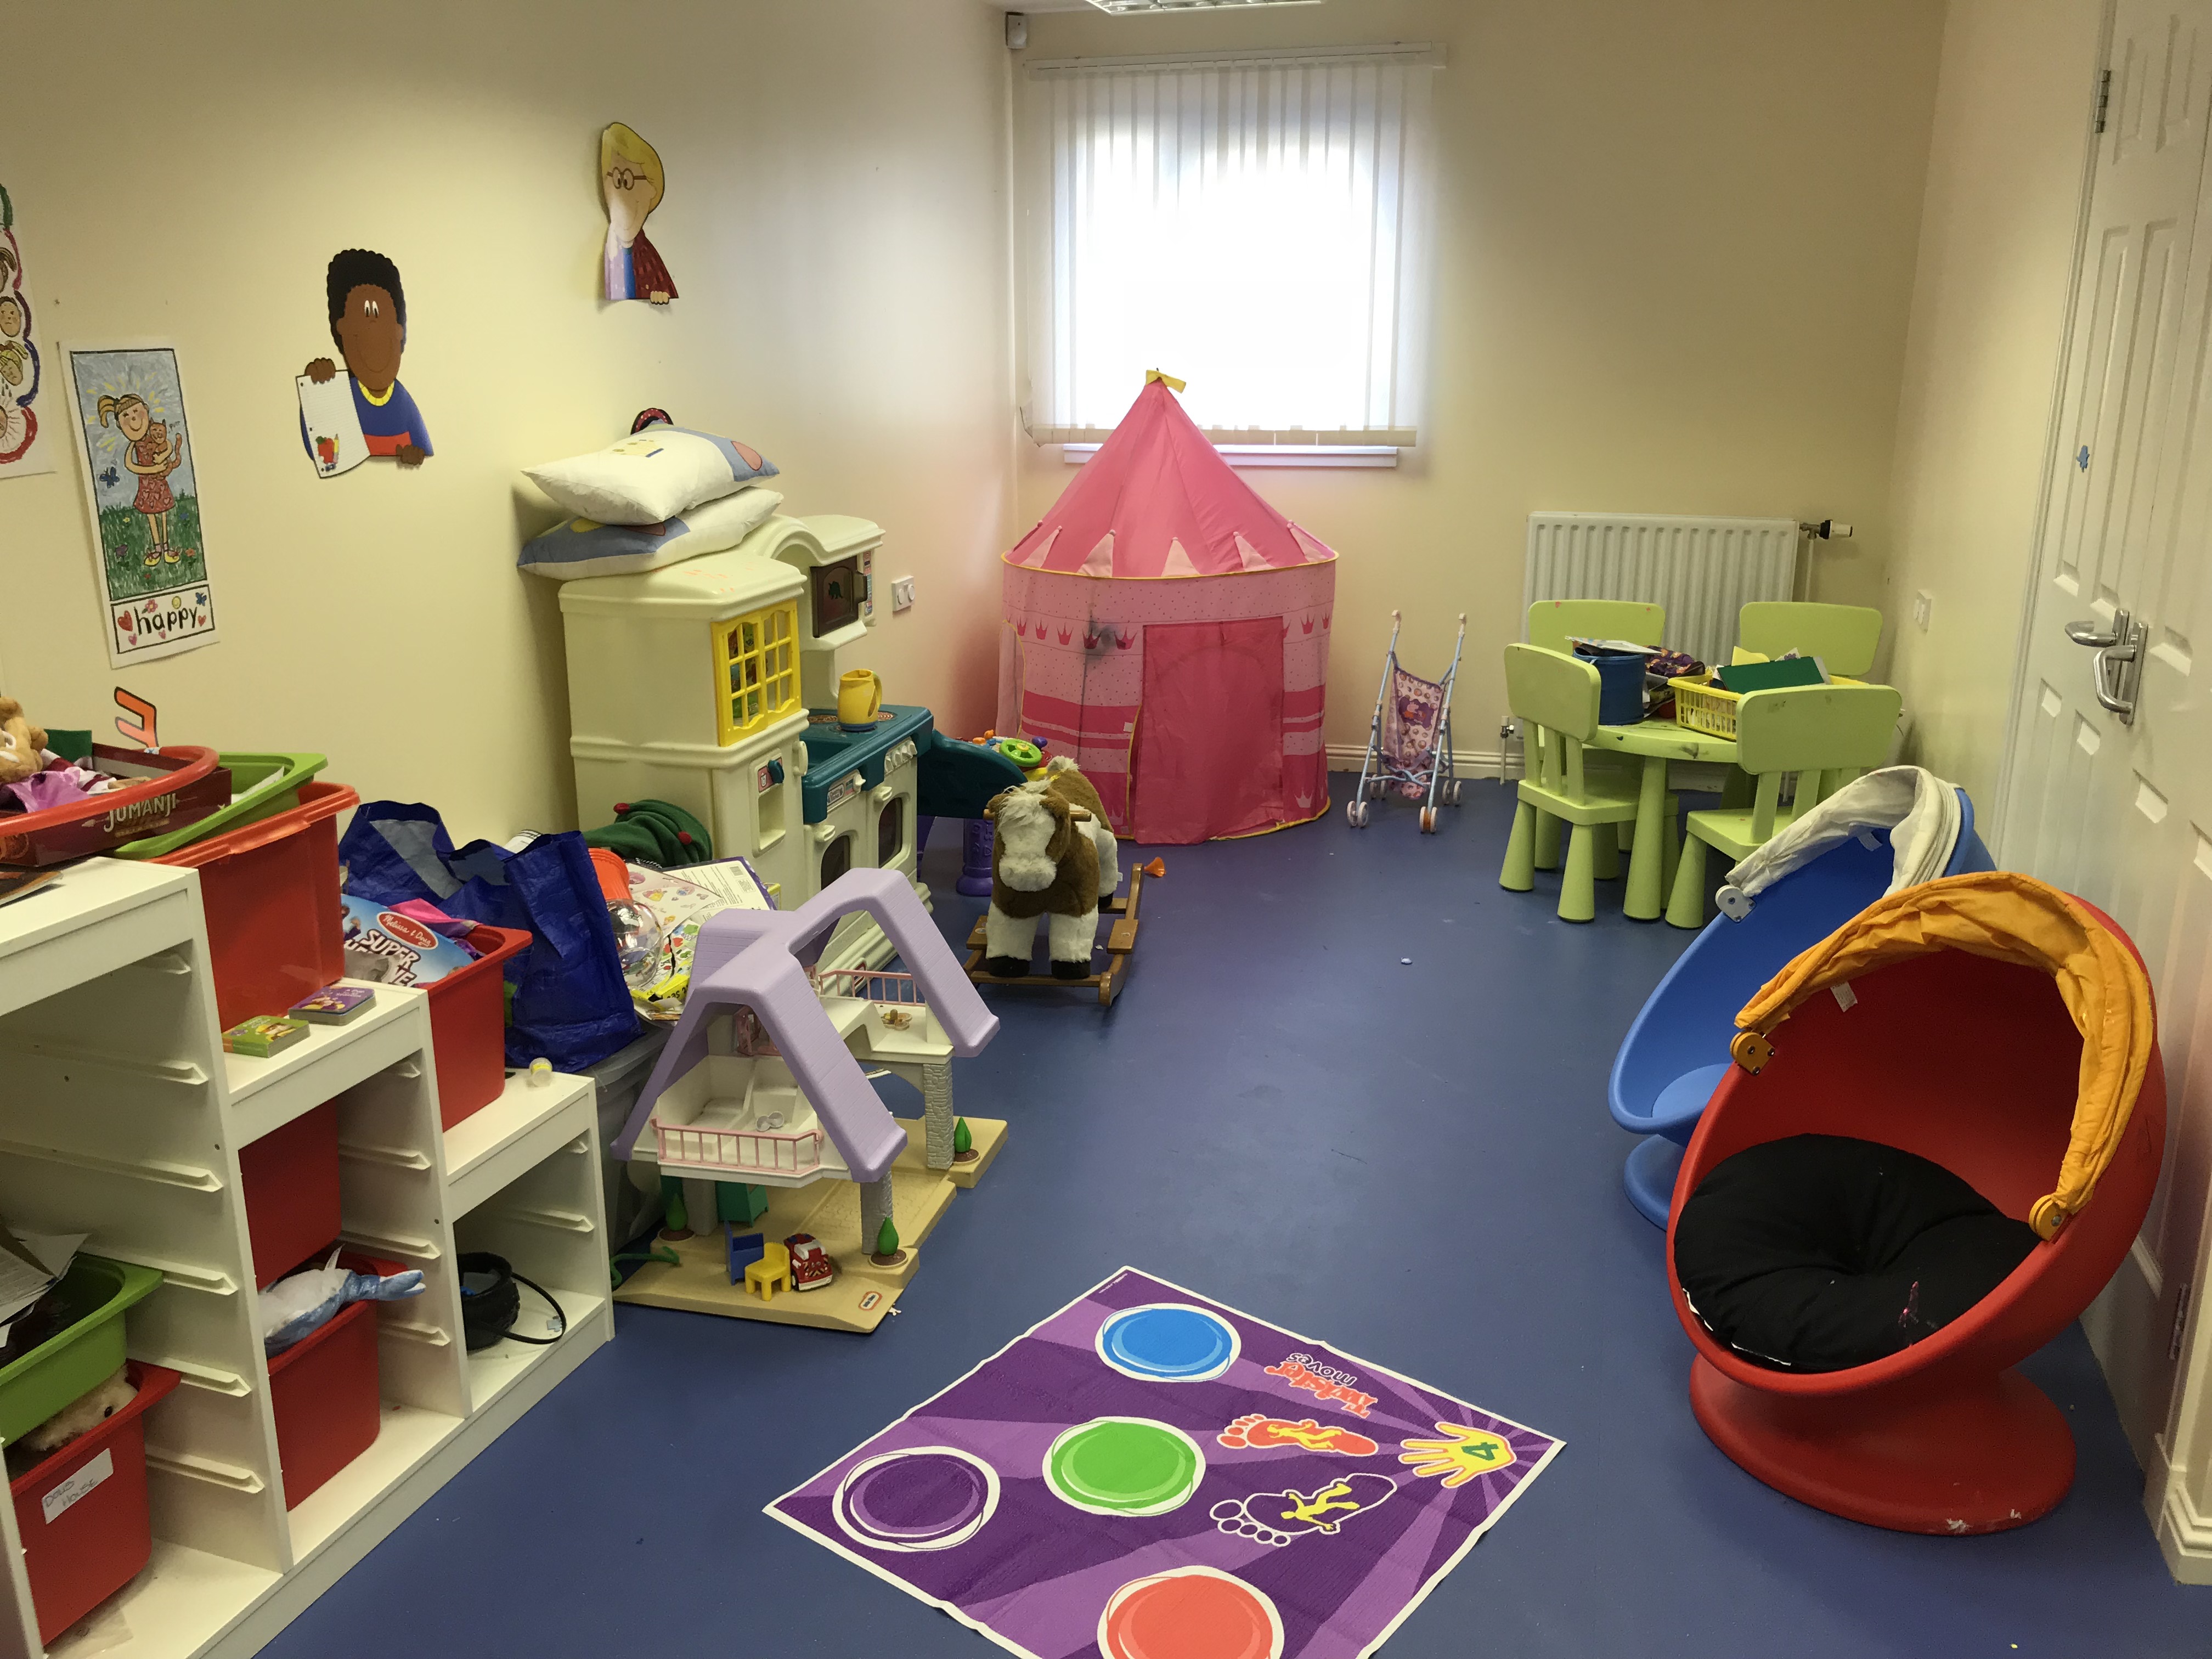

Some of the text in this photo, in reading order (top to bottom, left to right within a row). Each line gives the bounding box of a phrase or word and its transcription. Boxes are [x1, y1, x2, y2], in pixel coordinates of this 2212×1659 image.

[134, 606, 198, 635] happy
[104, 793, 176, 832] JUMANJI
[383, 915, 410, 933] Melissa
[416, 932, 431, 947] Doug
[360, 929, 420, 970] SUPER
[1286, 1353, 1357, 1386] moves
[1264, 1361, 1378, 1419] Twister
[1462, 1442, 1499, 1461] 4
